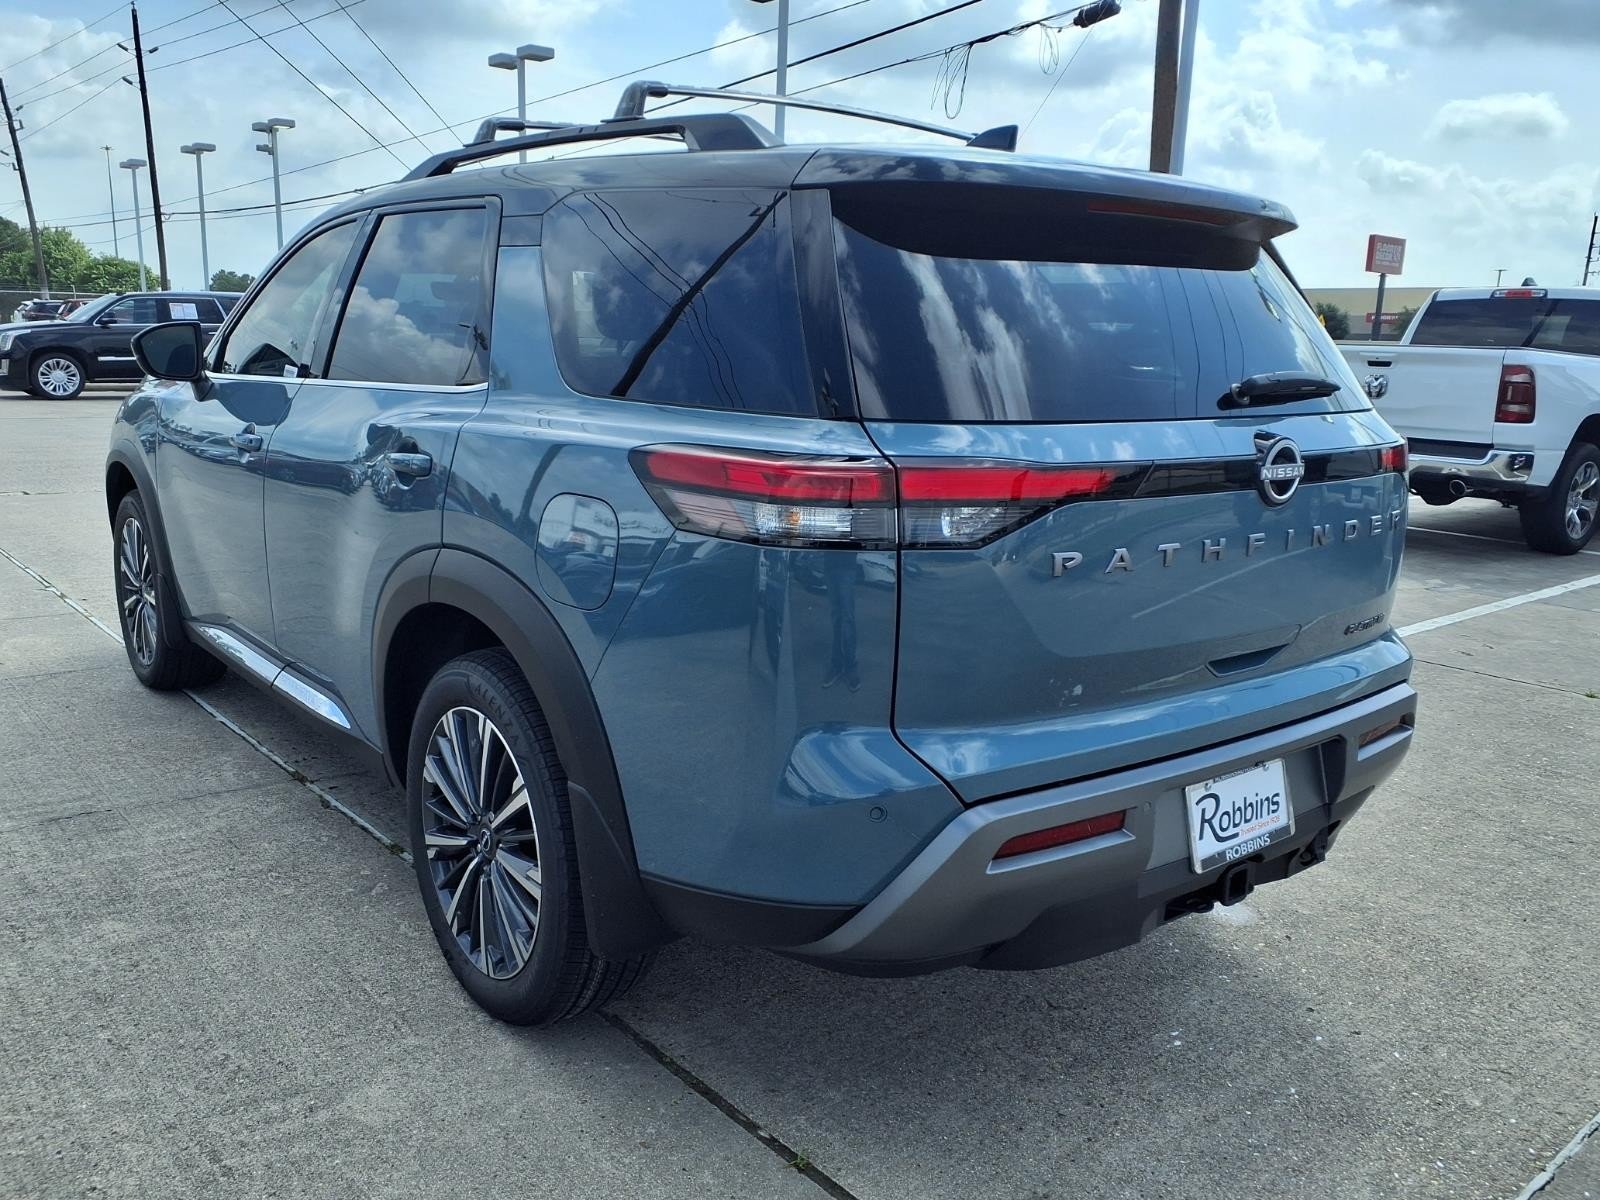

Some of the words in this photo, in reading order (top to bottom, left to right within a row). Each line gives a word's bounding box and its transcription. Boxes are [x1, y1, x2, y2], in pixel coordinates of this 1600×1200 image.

[1262, 466, 1304, 479] NISSAN
[1195, 791, 1280, 843] Robbins
[1225, 833, 1271, 861] ROBBINS
